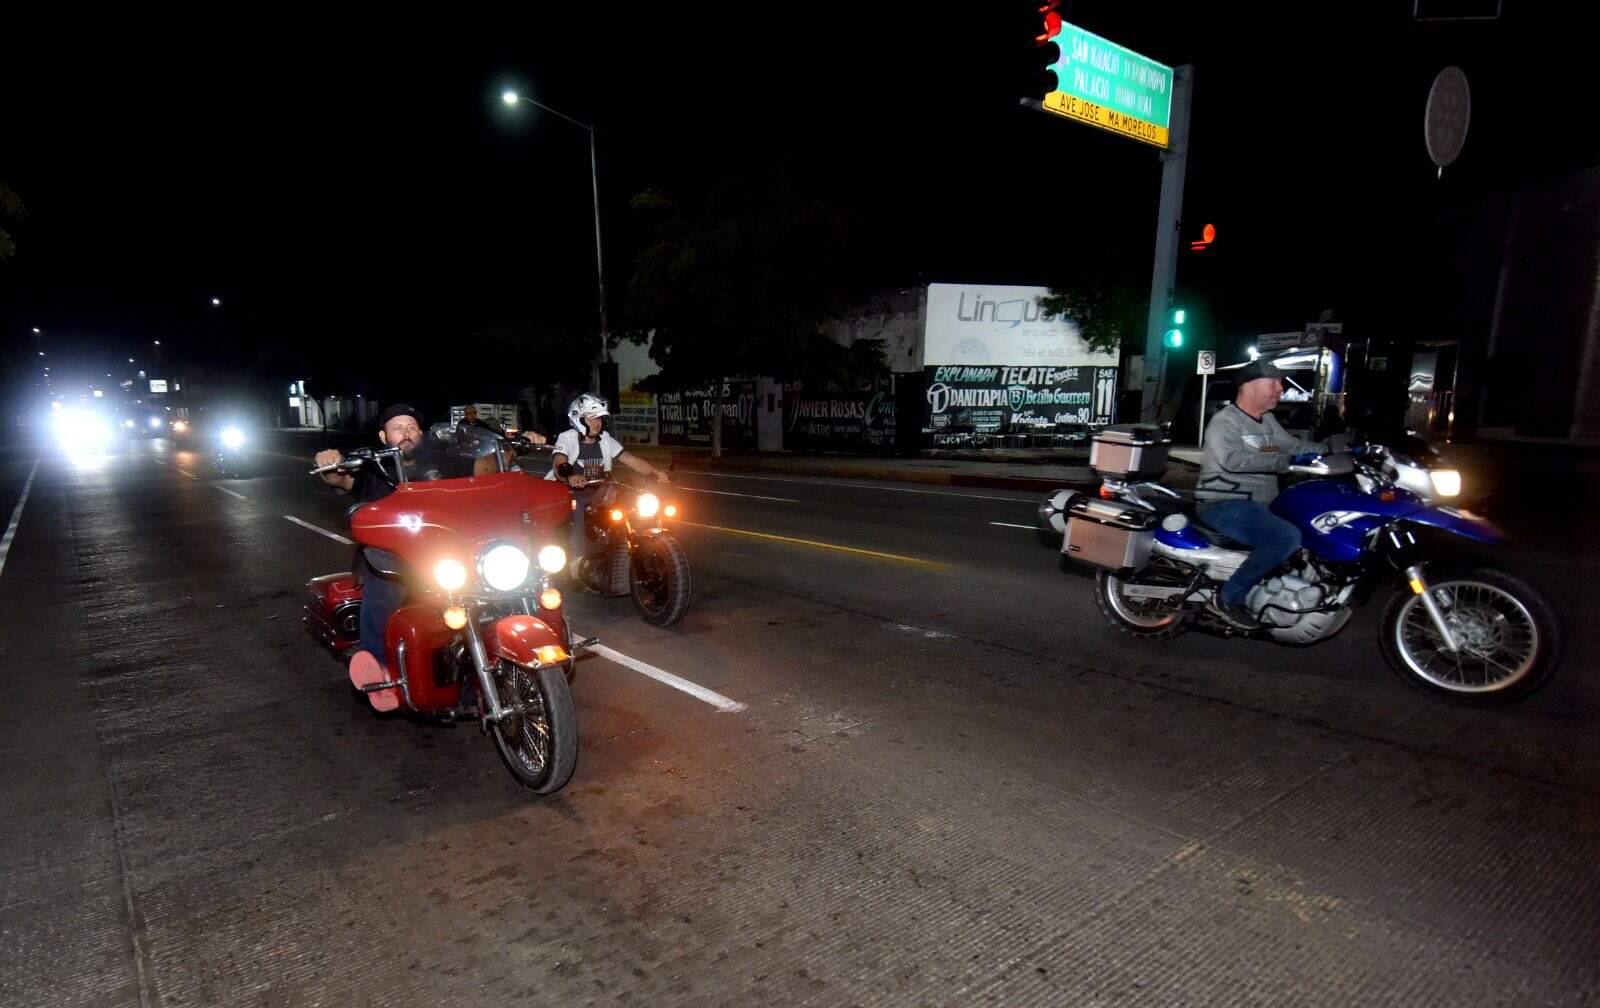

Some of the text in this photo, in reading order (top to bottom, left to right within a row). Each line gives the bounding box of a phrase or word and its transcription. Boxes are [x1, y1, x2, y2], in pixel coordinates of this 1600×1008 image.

[1072, 36, 1088, 63] SAN
[1074, 67, 1110, 101] PALACIO
[1060, 94, 1076, 112] AVE
[1080, 102, 1100, 121] JOSE
[934, 367, 998, 383] EXPLANADA
[1000, 368, 1055, 385] TECATE
[1097, 378, 1113, 415] 11
